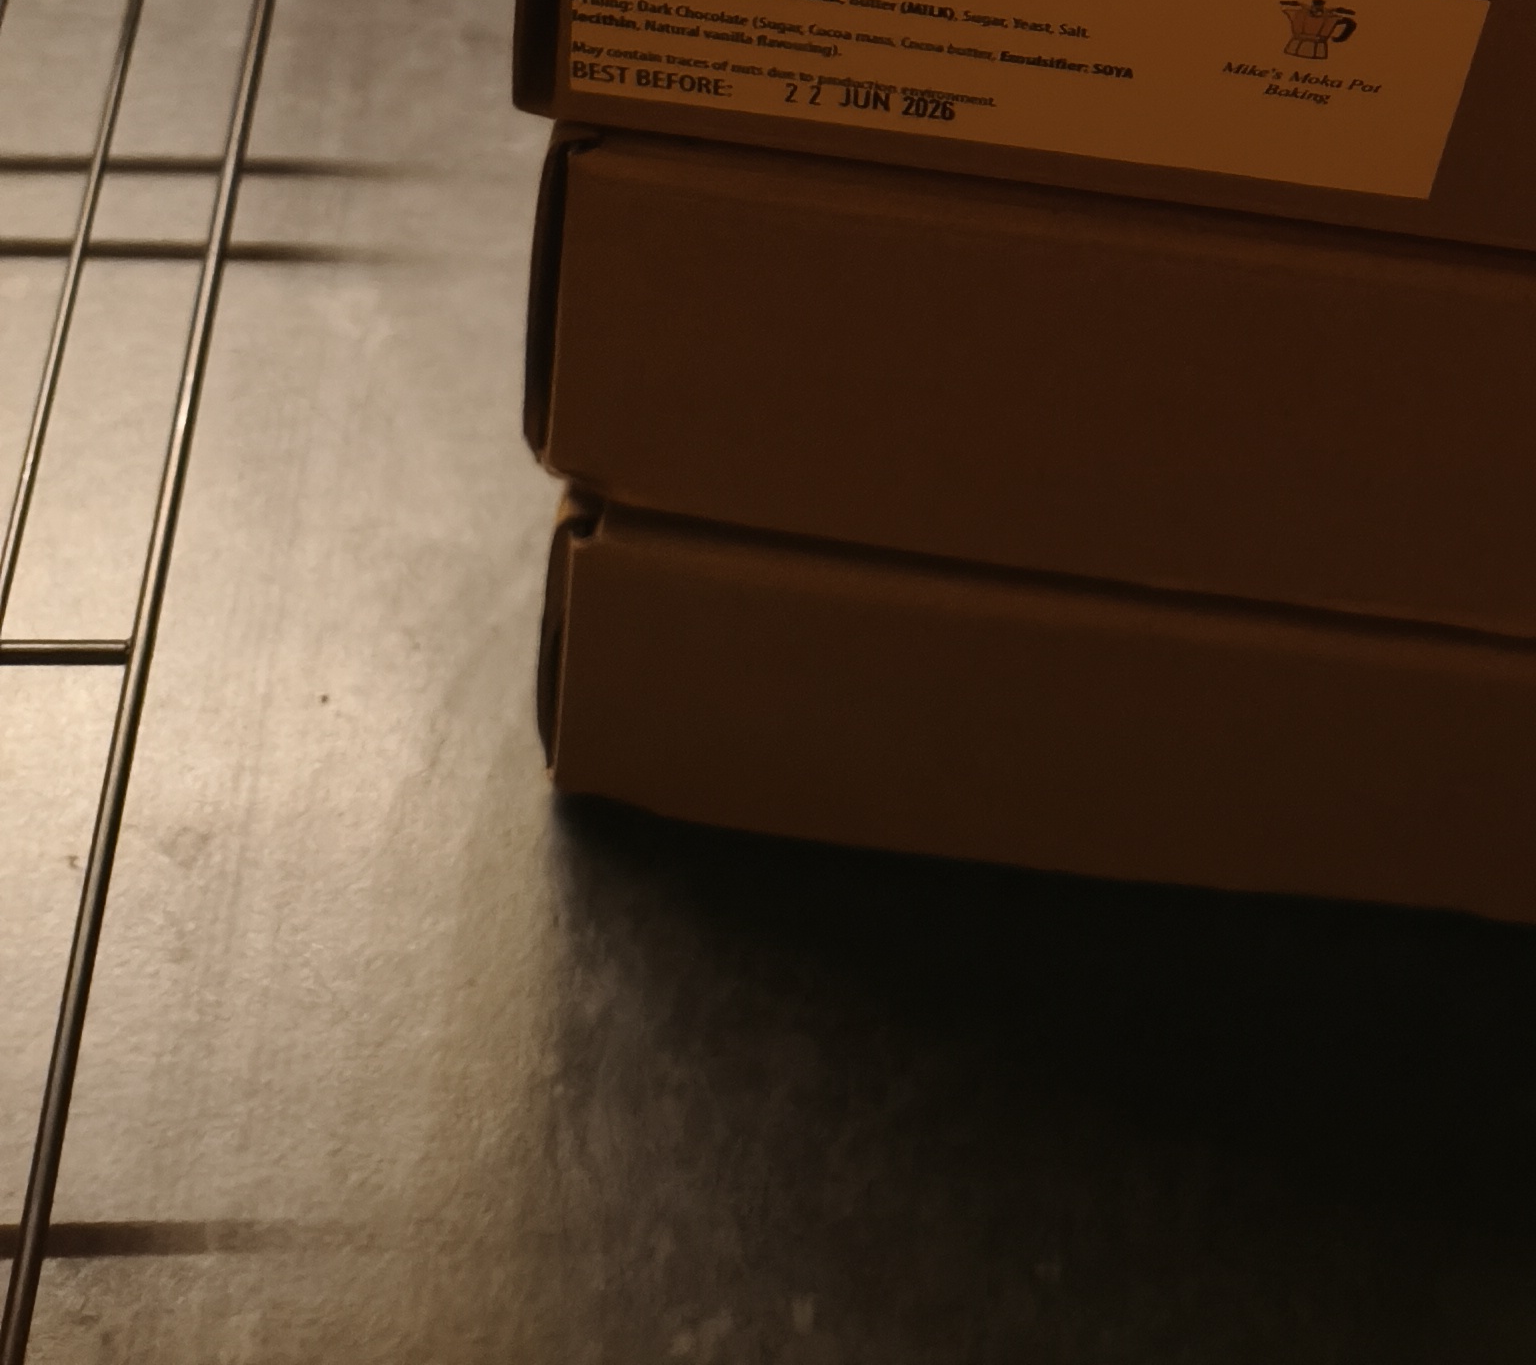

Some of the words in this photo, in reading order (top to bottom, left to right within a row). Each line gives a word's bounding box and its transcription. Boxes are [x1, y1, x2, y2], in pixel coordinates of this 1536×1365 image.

[571, 59, 631, 84] BEST
[635, 68, 734, 98] BEFORE:
[838, 87, 891, 112] JUN
[901, 95, 957, 121] 2026
[1222, 60, 1284, 80] Mike's
[1288, 70, 1344, 89] Moka
[1347, 78, 1383, 94] Pot
[1263, 82, 1332, 105] Baking
